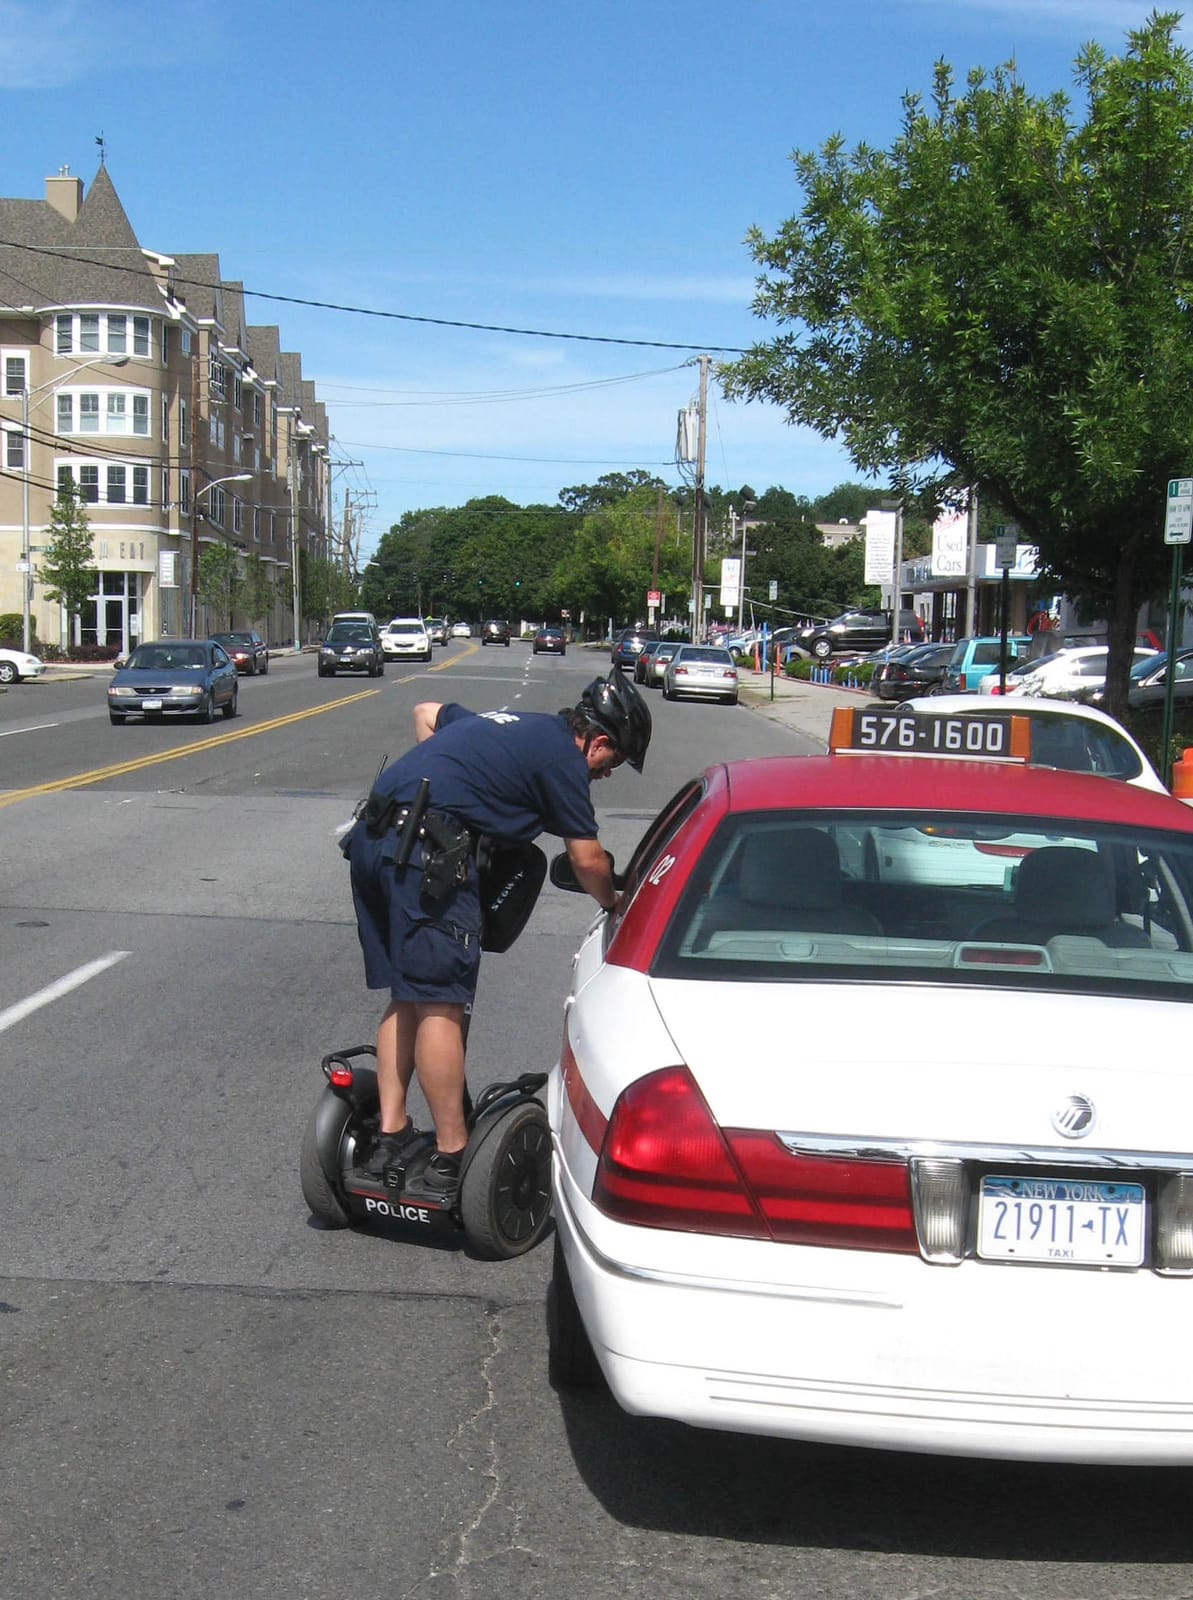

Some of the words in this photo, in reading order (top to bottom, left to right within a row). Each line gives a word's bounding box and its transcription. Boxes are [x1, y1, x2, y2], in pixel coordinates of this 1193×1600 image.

[937, 535, 963, 552] Used
[936, 554, 963, 572] Cars
[860, 715, 1003, 751] 576-1600
[648, 854, 676, 885] 02
[1022, 1182, 1059, 1199] NEW
[1063, 1184, 1105, 1202] YORK
[365, 1198, 431, 1224] POLICE
[993, 1201, 1074, 1244] 21911
[1098, 1206, 1129, 1246] TX
[1047, 1248, 1075, 1259] TAXI
